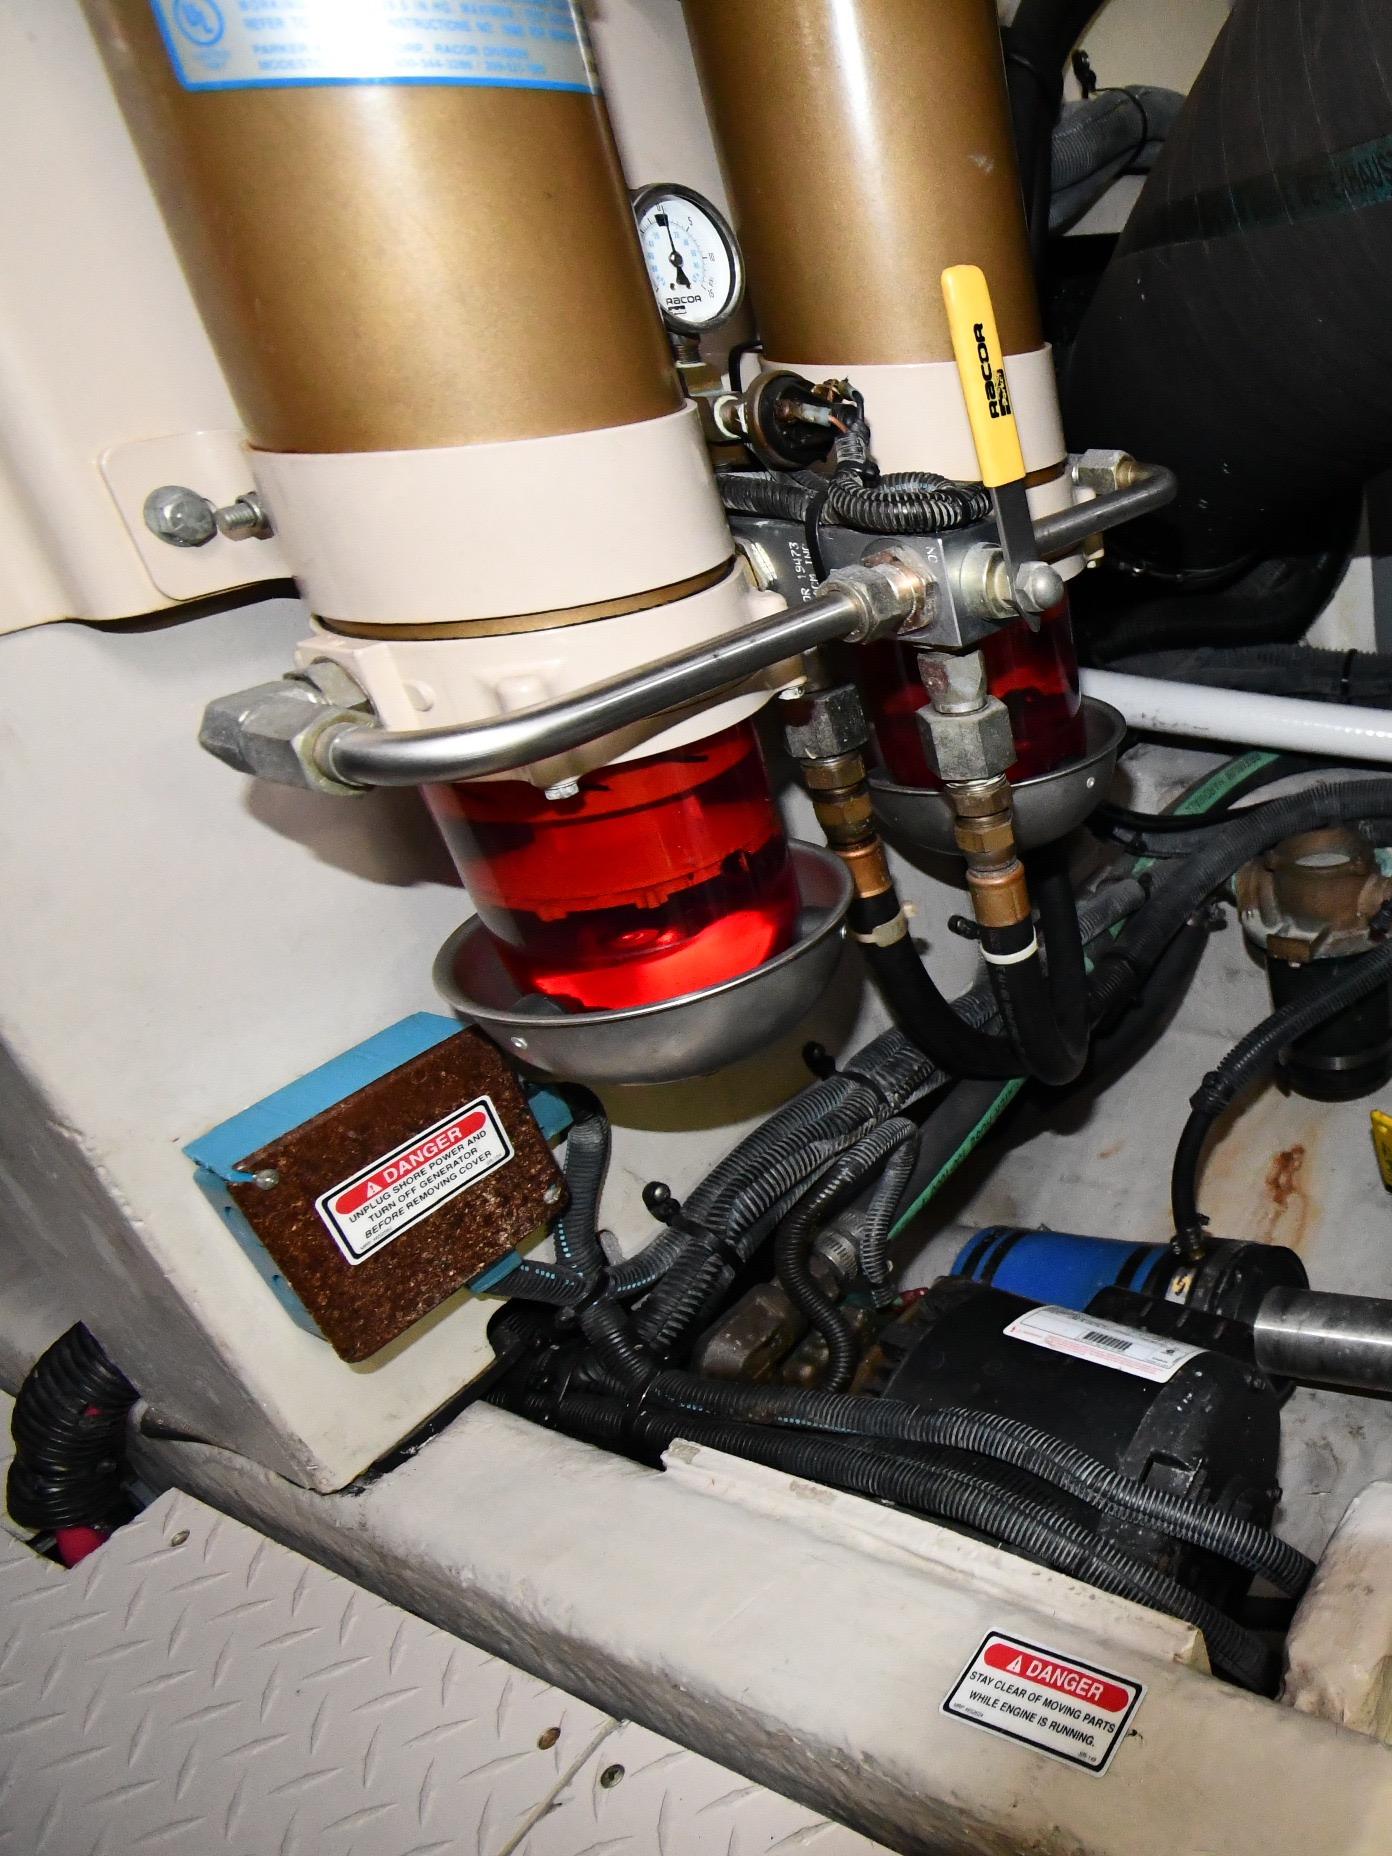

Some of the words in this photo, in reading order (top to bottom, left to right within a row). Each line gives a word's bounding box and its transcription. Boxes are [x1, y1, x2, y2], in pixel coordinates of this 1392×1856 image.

[349, 1193, 392, 1224] UNPLUG
[392, 1168, 427, 1194] SHORE
[429, 1144, 465, 1169] POWER
[467, 1130, 488, 1147] AND
[368, 1201, 397, 1222] TURN
[397, 1186, 417, 1203] OFF
[419, 1147, 479, 1188] GENERATOR
[383, 1127, 463, 1184] DANGER
[365, 1208, 406, 1239] BEFORE
[406, 1172, 458, 1211] REMOVING
[459, 1150, 492, 1175] COVER
[969, 1671, 995, 1690] STAY
[994, 1679, 1027, 1699] CLEAR
[1027, 1691, 1043, 1704] OF
[1043, 1696, 1081, 1721] MOVING
[1082, 1712, 1116, 1734] PARTS
[1026, 1659, 1104, 1701] DANGER
[969, 1689, 998, 1709] WHILE
[999, 1700, 1037, 1724] ENGINE
[1036, 1714, 1048, 1728] IS
[1048, 1719, 1096, 1748] RUNNING.
